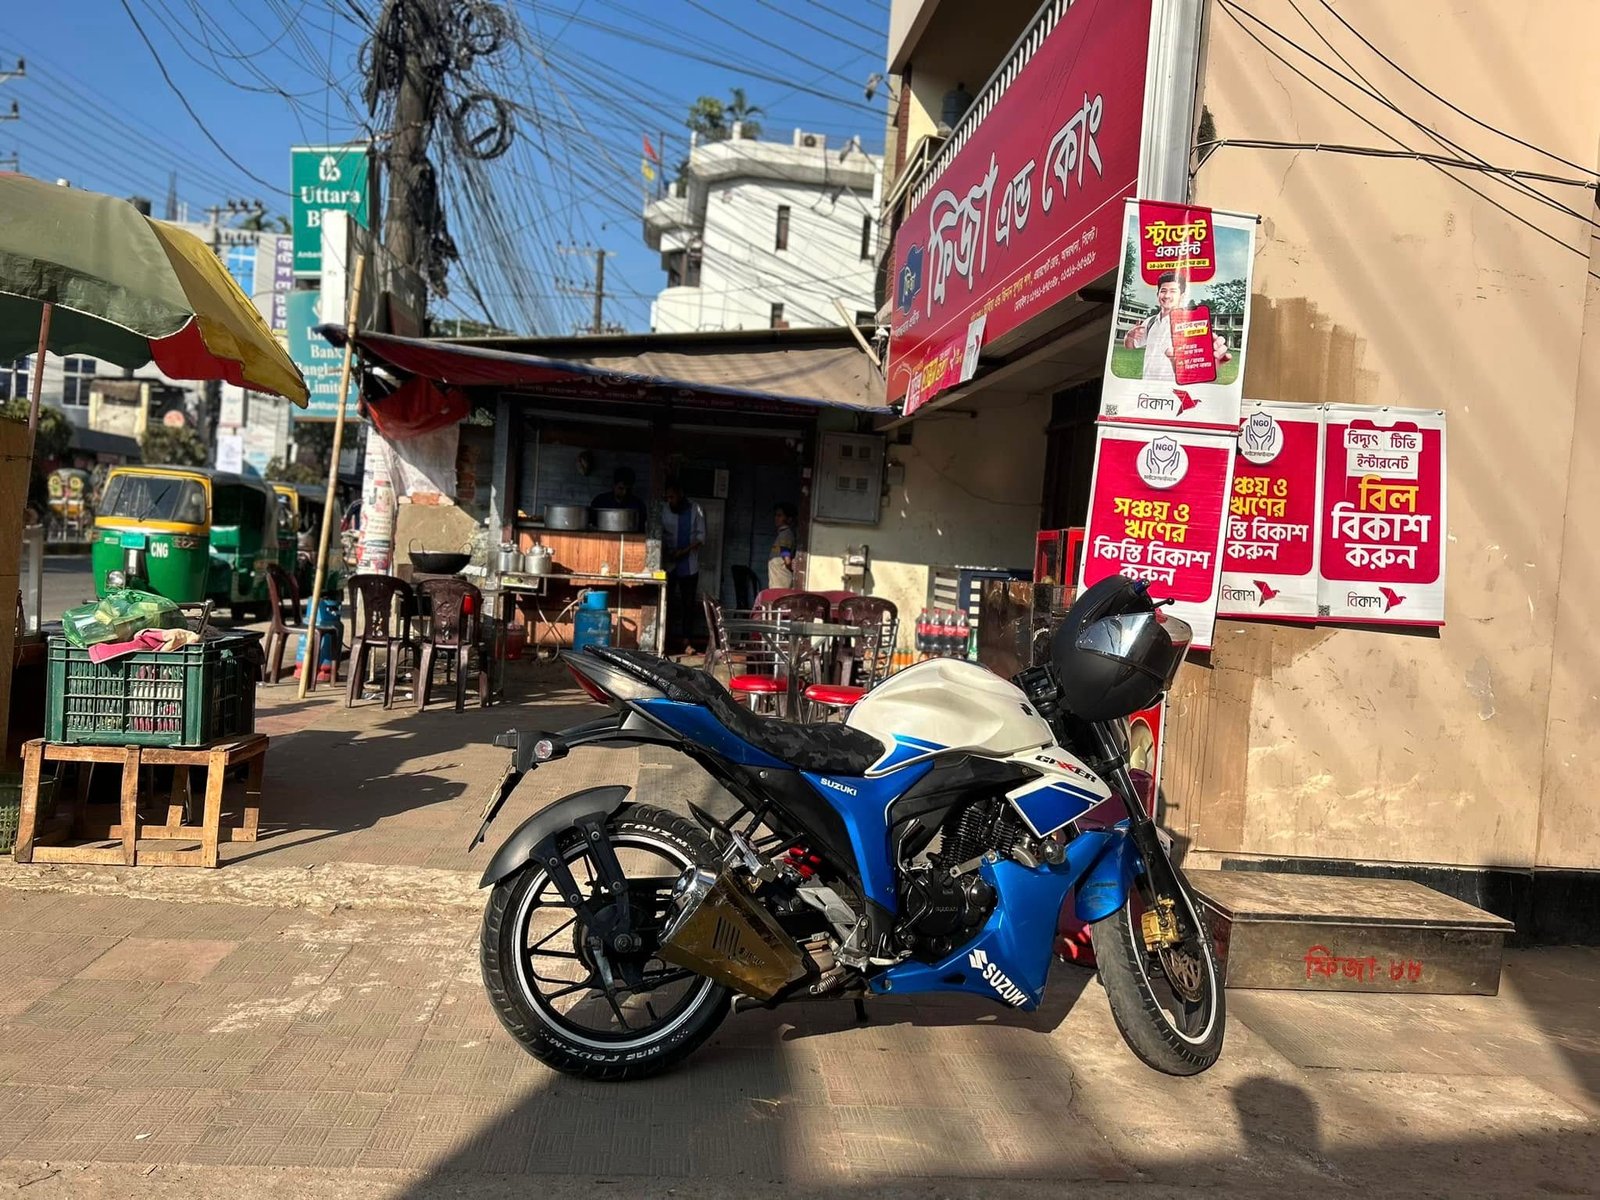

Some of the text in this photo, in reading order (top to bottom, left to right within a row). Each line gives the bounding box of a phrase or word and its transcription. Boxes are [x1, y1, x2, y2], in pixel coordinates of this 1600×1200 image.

[1042, 92, 1103, 212] কোং
[300, 186, 361, 204] Uttara
[1144, 220, 1207, 246] স্টুডেন্ট
[1137, 392, 1175, 411] বিকাশ
[1155, 443, 1173, 451] NGO
[1348, 430, 1417, 449] বিদ্যুৎ টিভি
[1357, 453, 1409, 470] ইন্টারনেট
[1233, 476, 1288, 497] ঞ্চয় ও
[1358, 474, 1420, 513] বিল
[1114, 497, 1190, 522] সঞ্চয় ও
[1230, 496, 1287, 517] ঋণের
[1124, 519, 1188, 543] ঋণের
[1251, 517, 1309, 542] বিকাশ
[1331, 501, 1432, 543] বিকাশ
[151, 542, 169, 558] CNG
[1094, 536, 1211, 569] কিস্তি বিকাশ
[1227, 540, 1279, 561] করুন
[1344, 543, 1418, 571] করুন
[1221, 585, 1256, 602] বিকাশ
[1347, 591, 1382, 608] বিকাশ
[1035, 755, 1097, 783] GIXXER
[820, 777, 858, 797] SUZUKI
[983, 962, 1028, 1007] SUZUKI
